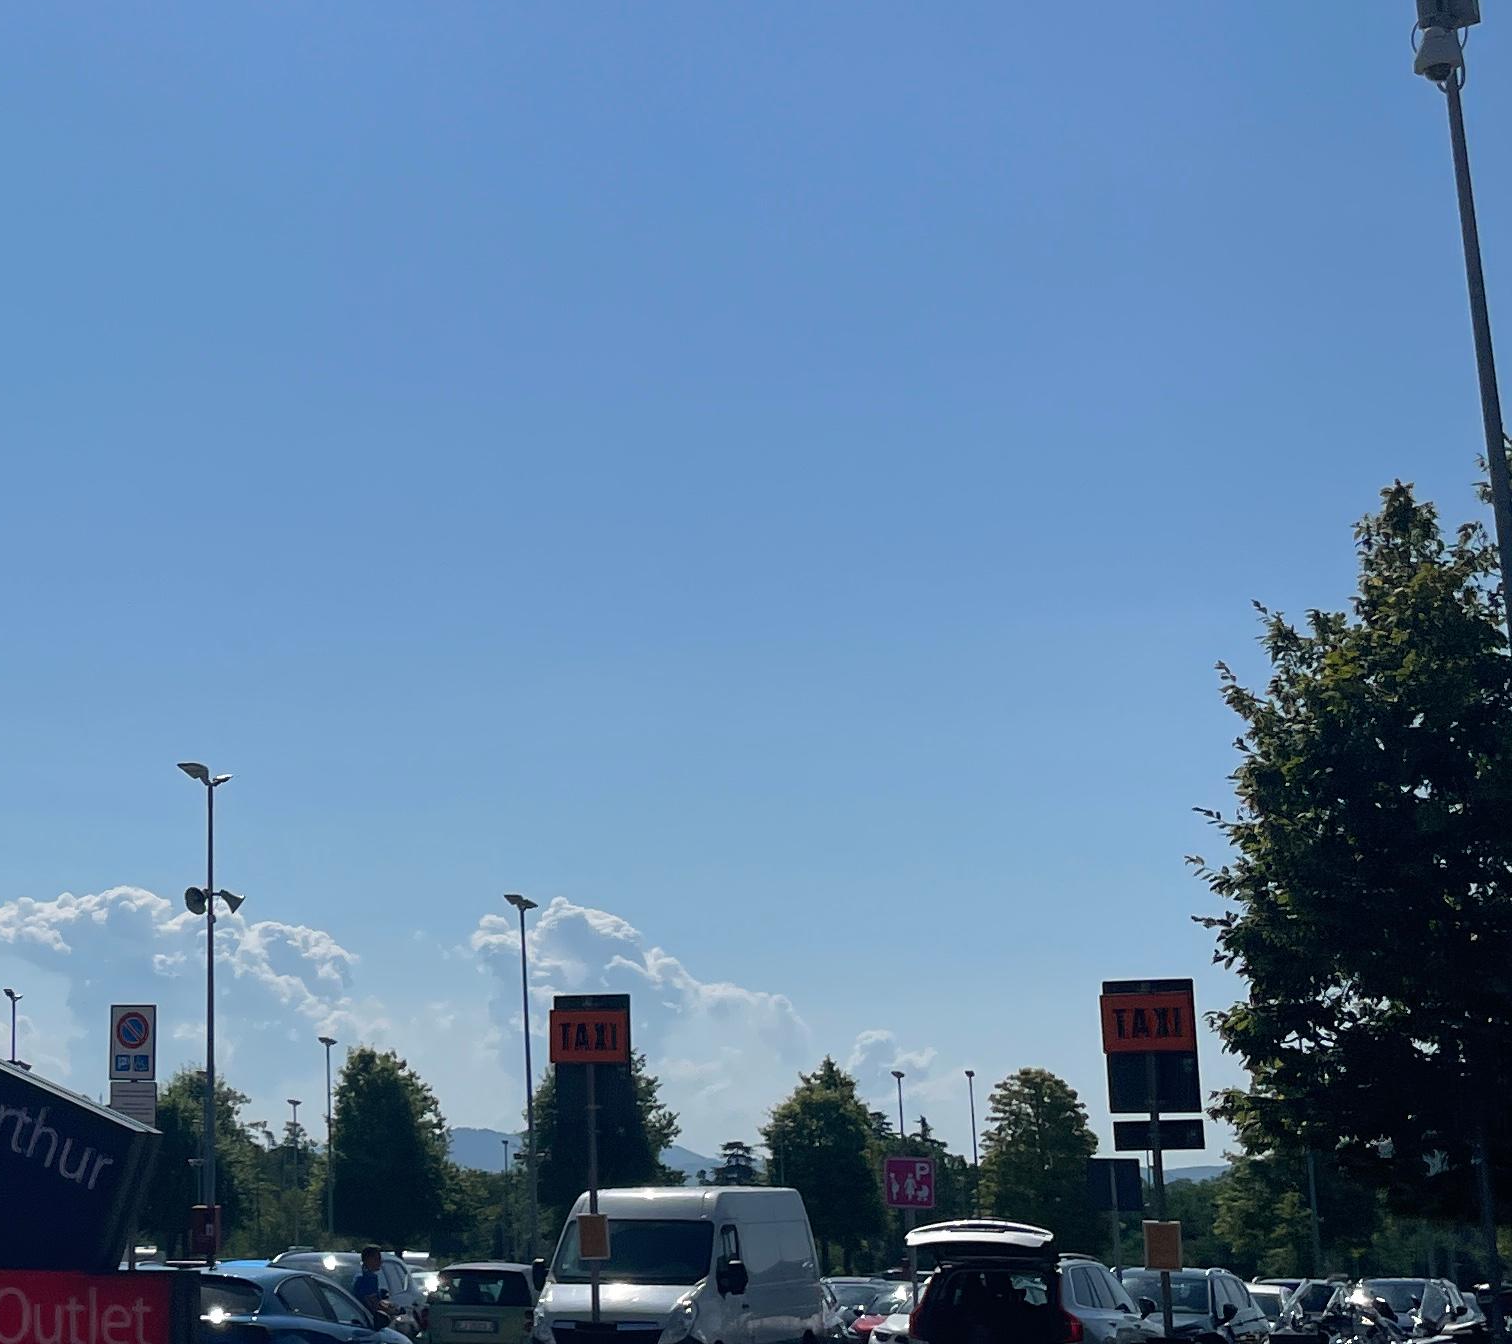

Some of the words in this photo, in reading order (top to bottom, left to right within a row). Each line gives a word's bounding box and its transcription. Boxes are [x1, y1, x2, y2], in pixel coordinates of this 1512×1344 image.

[560, 1022, 617, 1051] TAXI
[1112, 1007, 1182, 1040] TAXI
[915, 1162, 930, 1181] P
